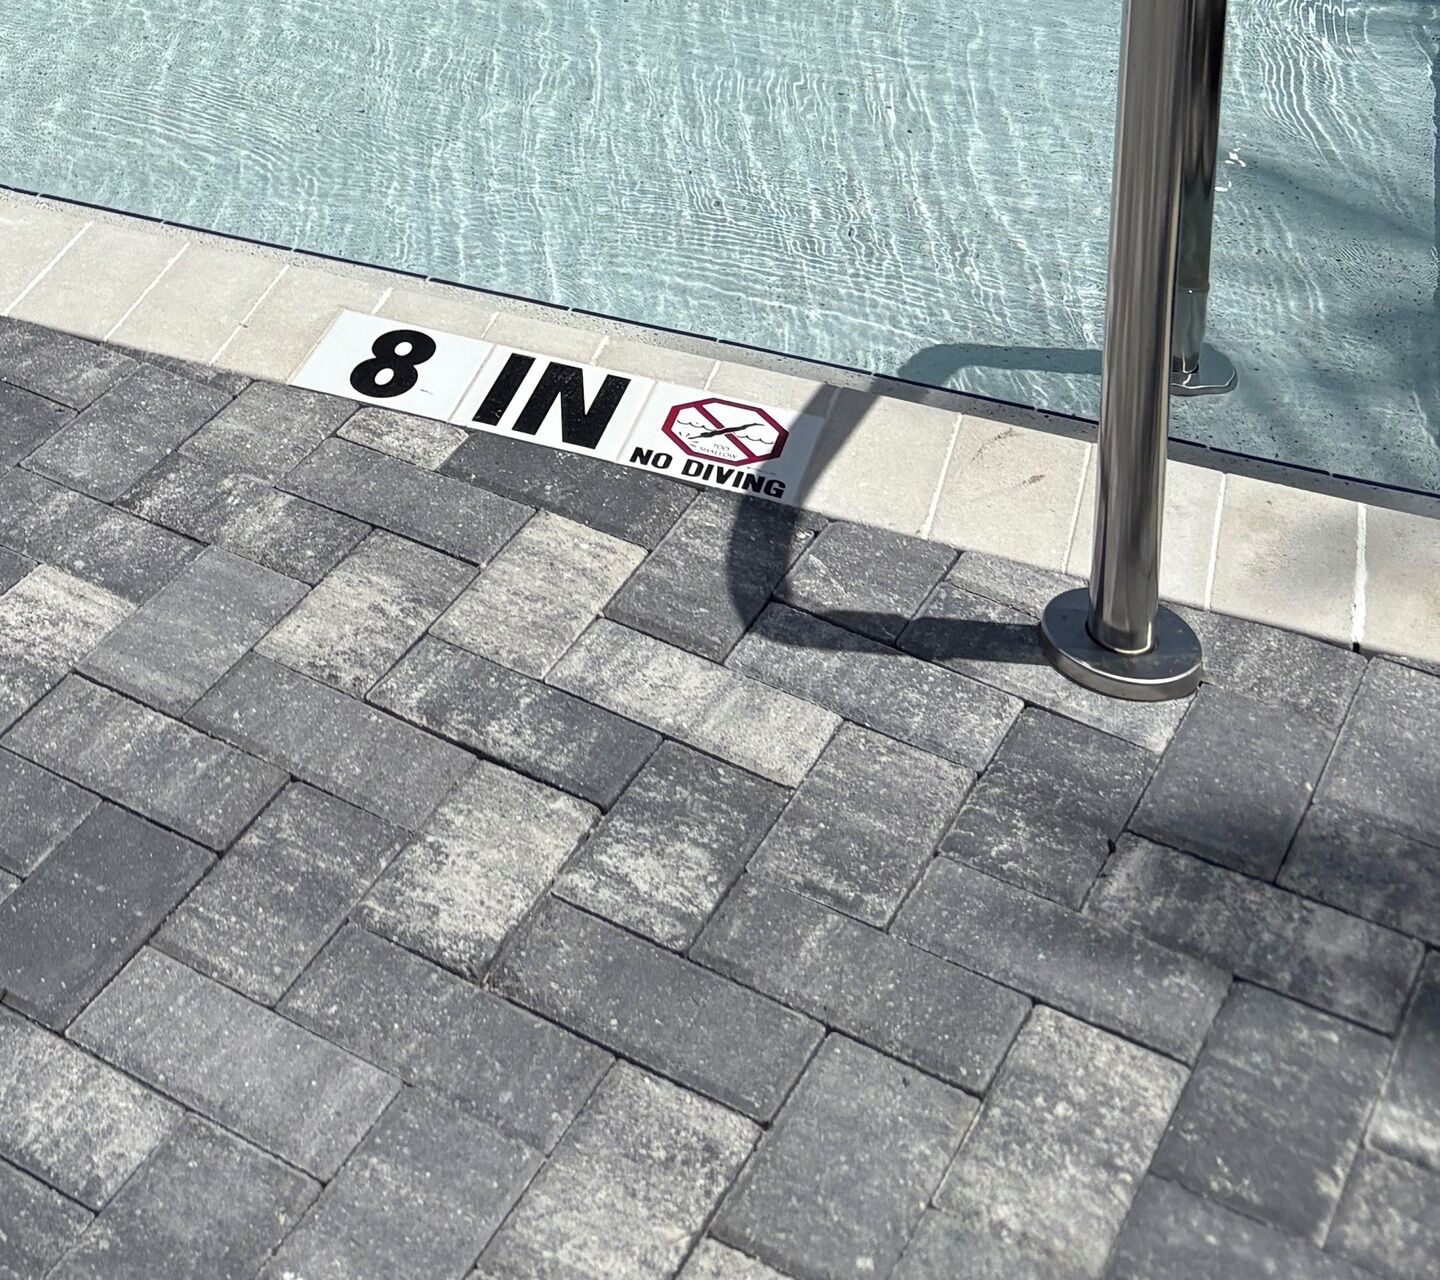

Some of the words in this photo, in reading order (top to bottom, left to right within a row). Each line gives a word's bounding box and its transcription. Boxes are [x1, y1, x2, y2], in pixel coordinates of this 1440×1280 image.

[349, 329, 437, 399] 8
[472, 352, 632, 450] IN
[628, 446, 674, 470] NO
[680, 458, 787, 499] DIVING
[712, 442, 731, 452] TOO
